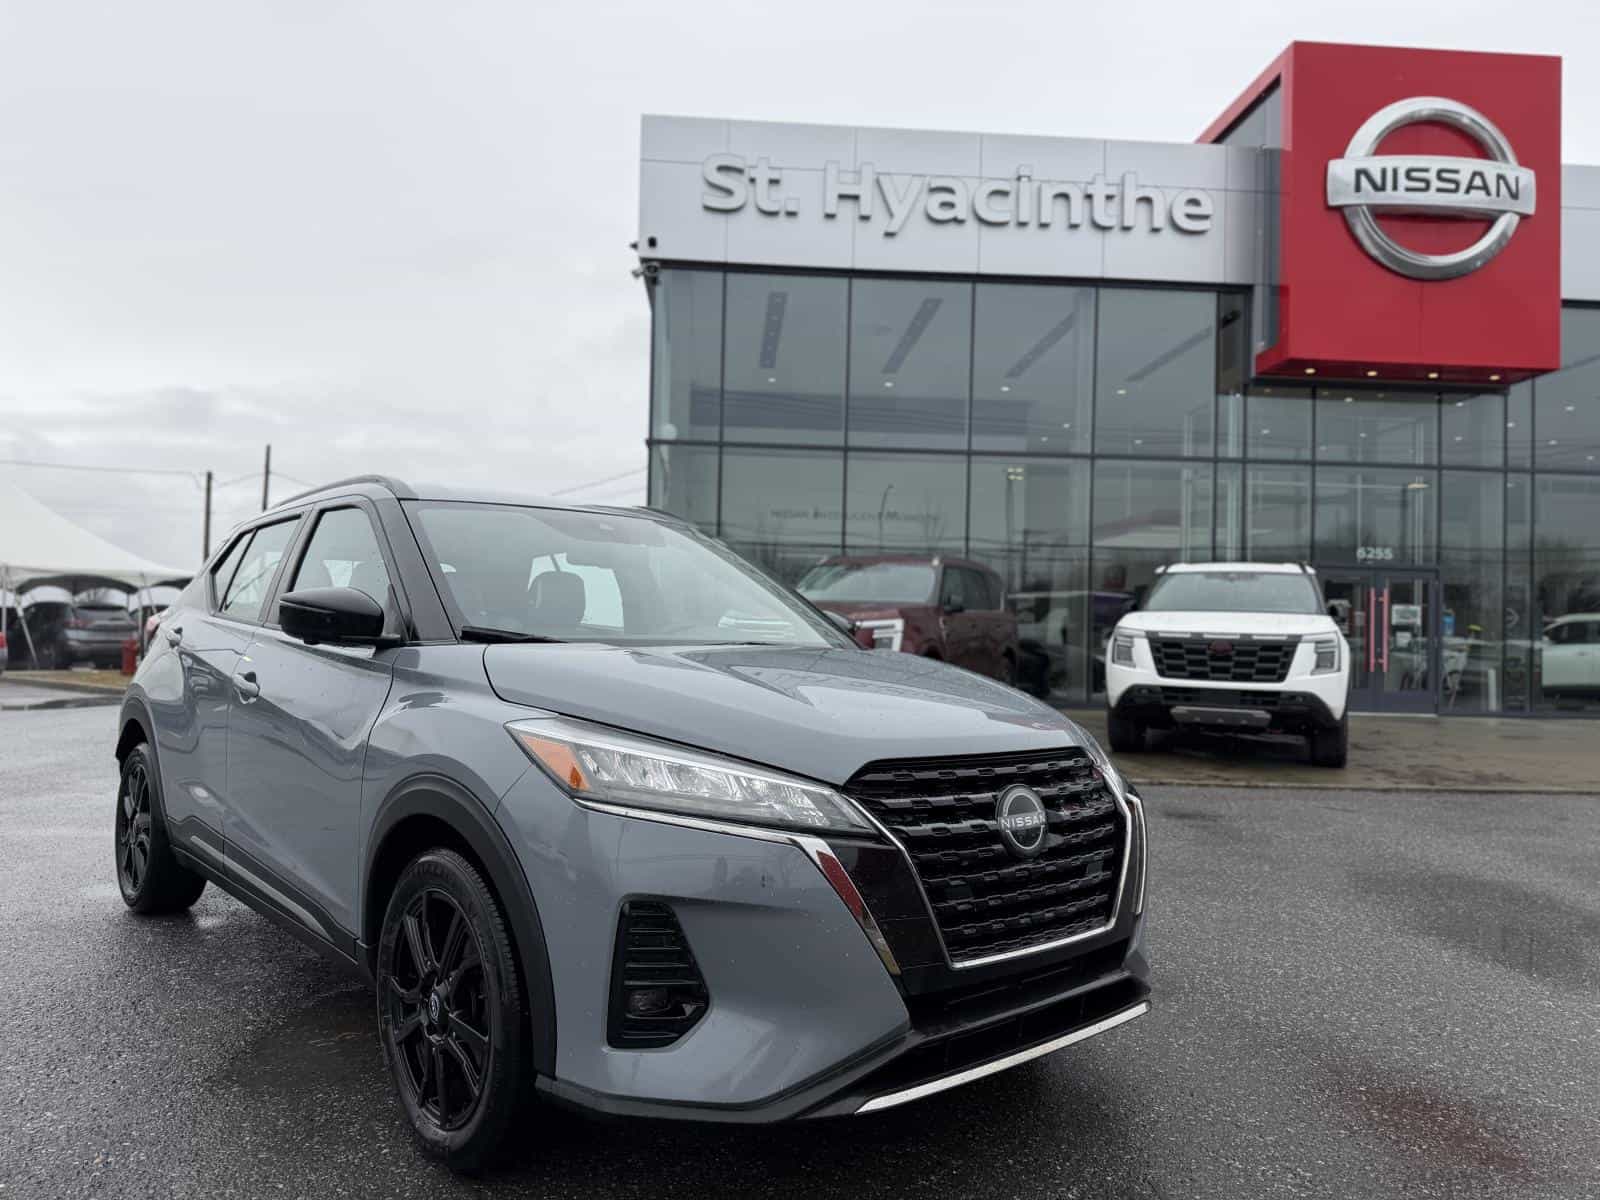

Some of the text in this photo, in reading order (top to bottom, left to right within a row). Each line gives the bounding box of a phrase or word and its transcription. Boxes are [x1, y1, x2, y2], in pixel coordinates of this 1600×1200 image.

[702, 154, 1214, 236] St. Hyacinthe
[1354, 166, 1520, 201] NISSAN
[1001, 814, 1045, 830] NISSAN
